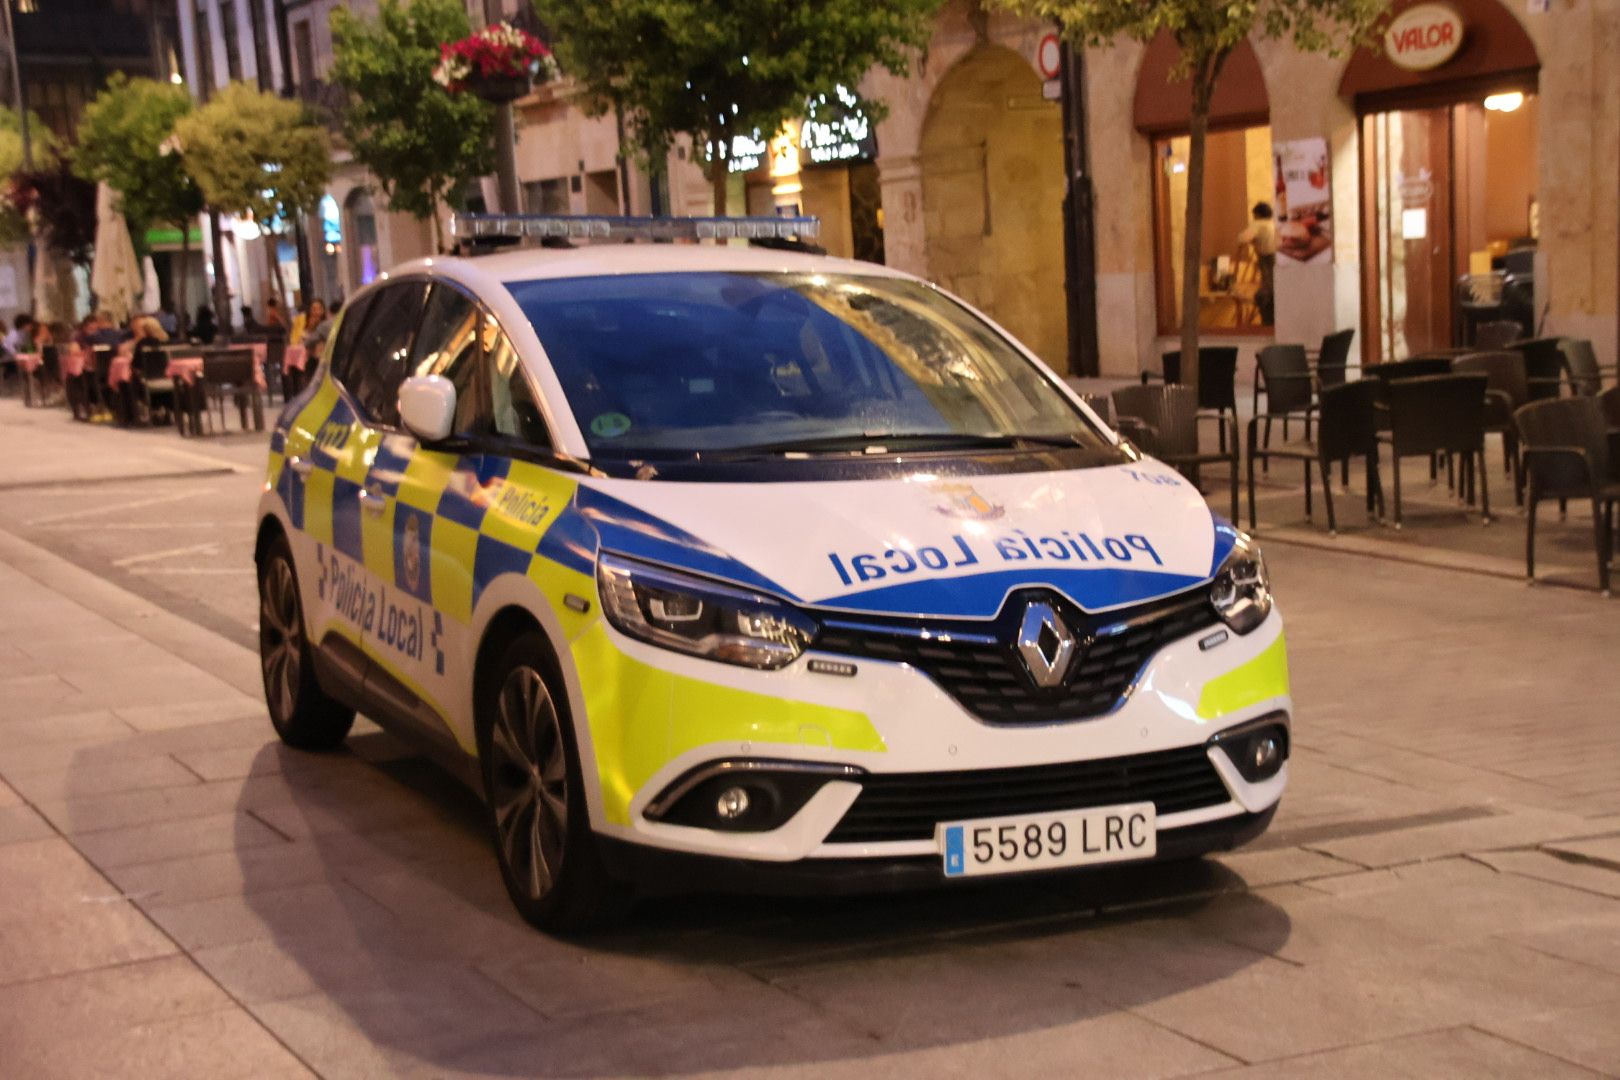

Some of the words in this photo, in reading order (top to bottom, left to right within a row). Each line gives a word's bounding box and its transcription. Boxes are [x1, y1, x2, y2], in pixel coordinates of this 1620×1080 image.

[1391, 21, 1454, 54] VALOR
[378, 584, 423, 662] Local
[973, 821, 1067, 863] 5589
[1082, 813, 1147, 854] LRC
